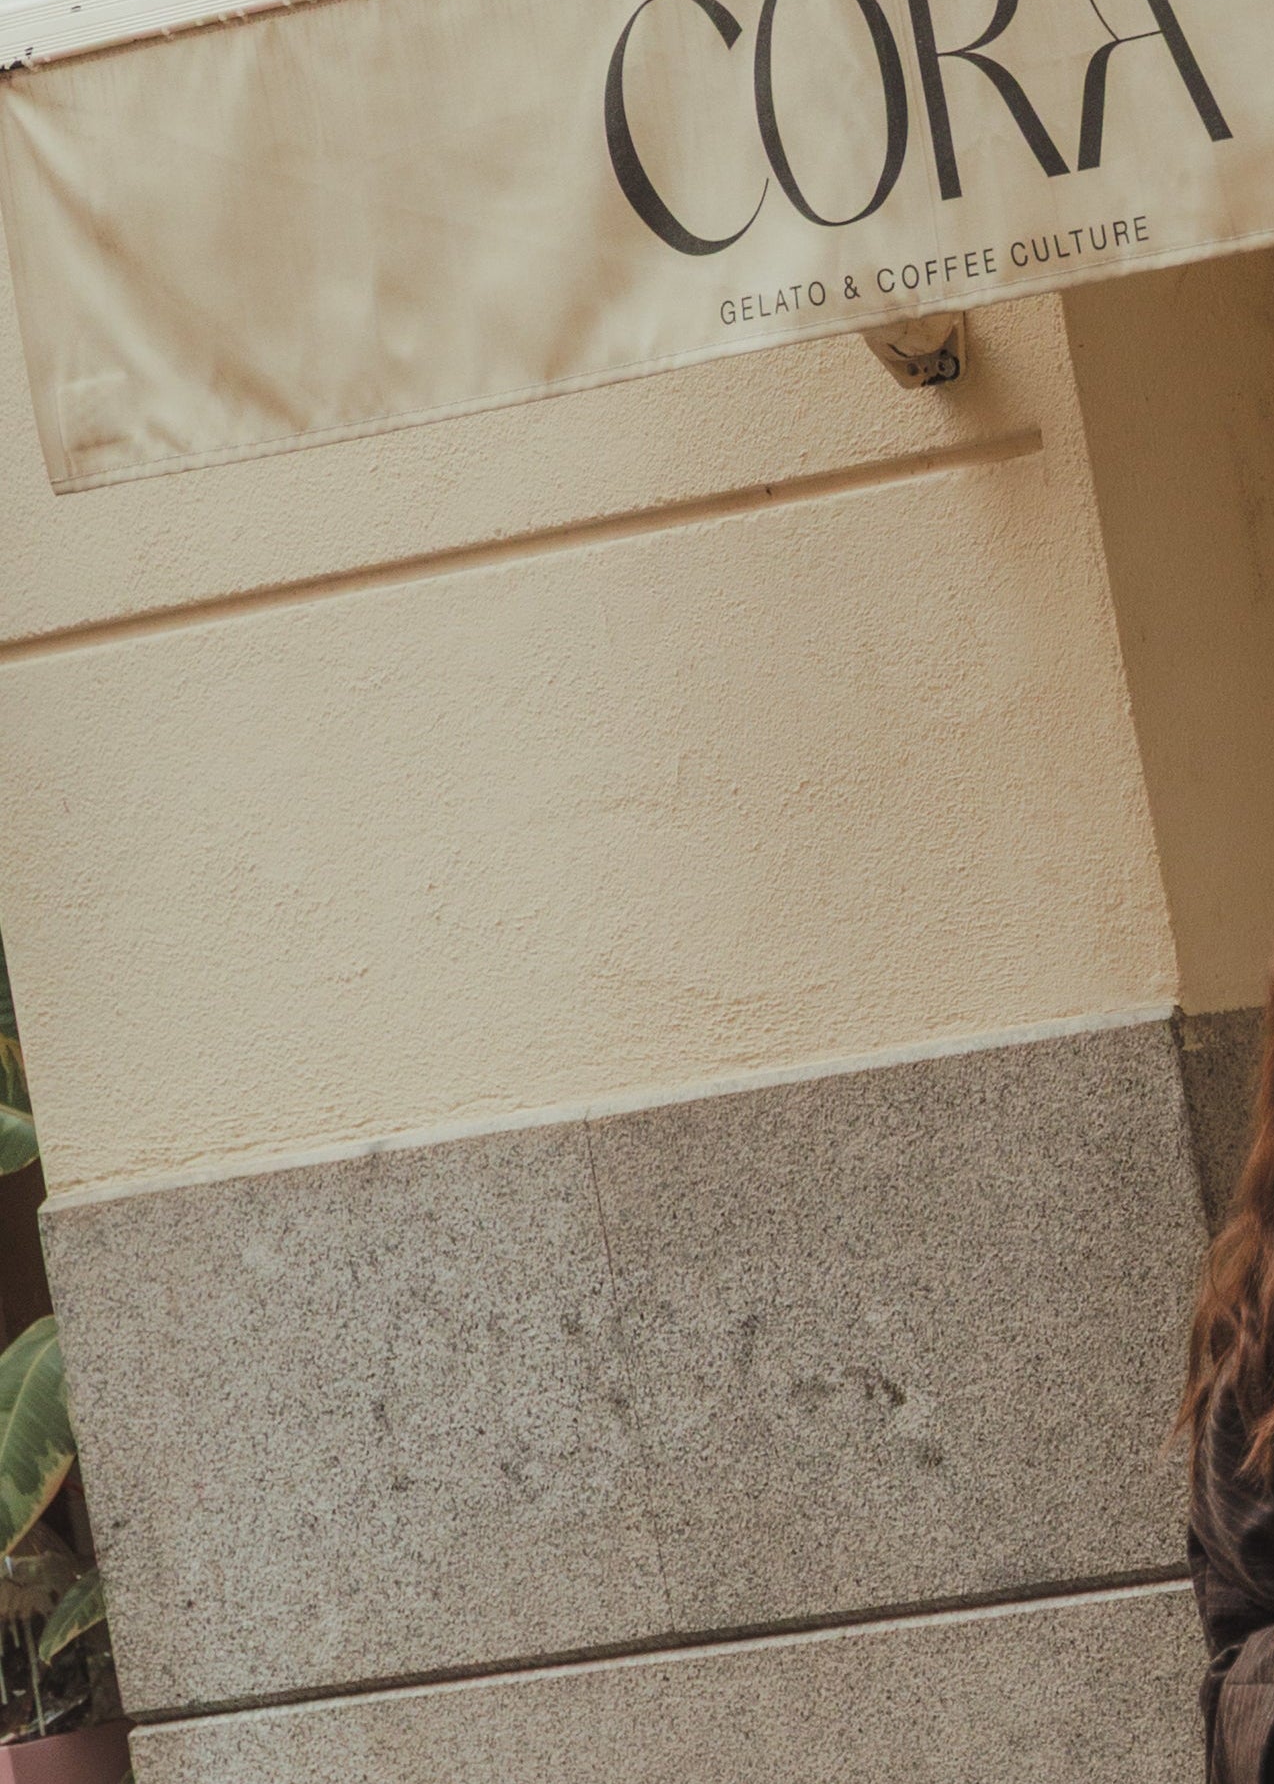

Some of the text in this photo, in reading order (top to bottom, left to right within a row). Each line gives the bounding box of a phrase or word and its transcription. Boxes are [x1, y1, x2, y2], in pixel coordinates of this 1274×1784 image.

[719, 216, 1151, 326] GELATO & COFFEE CULTURE
